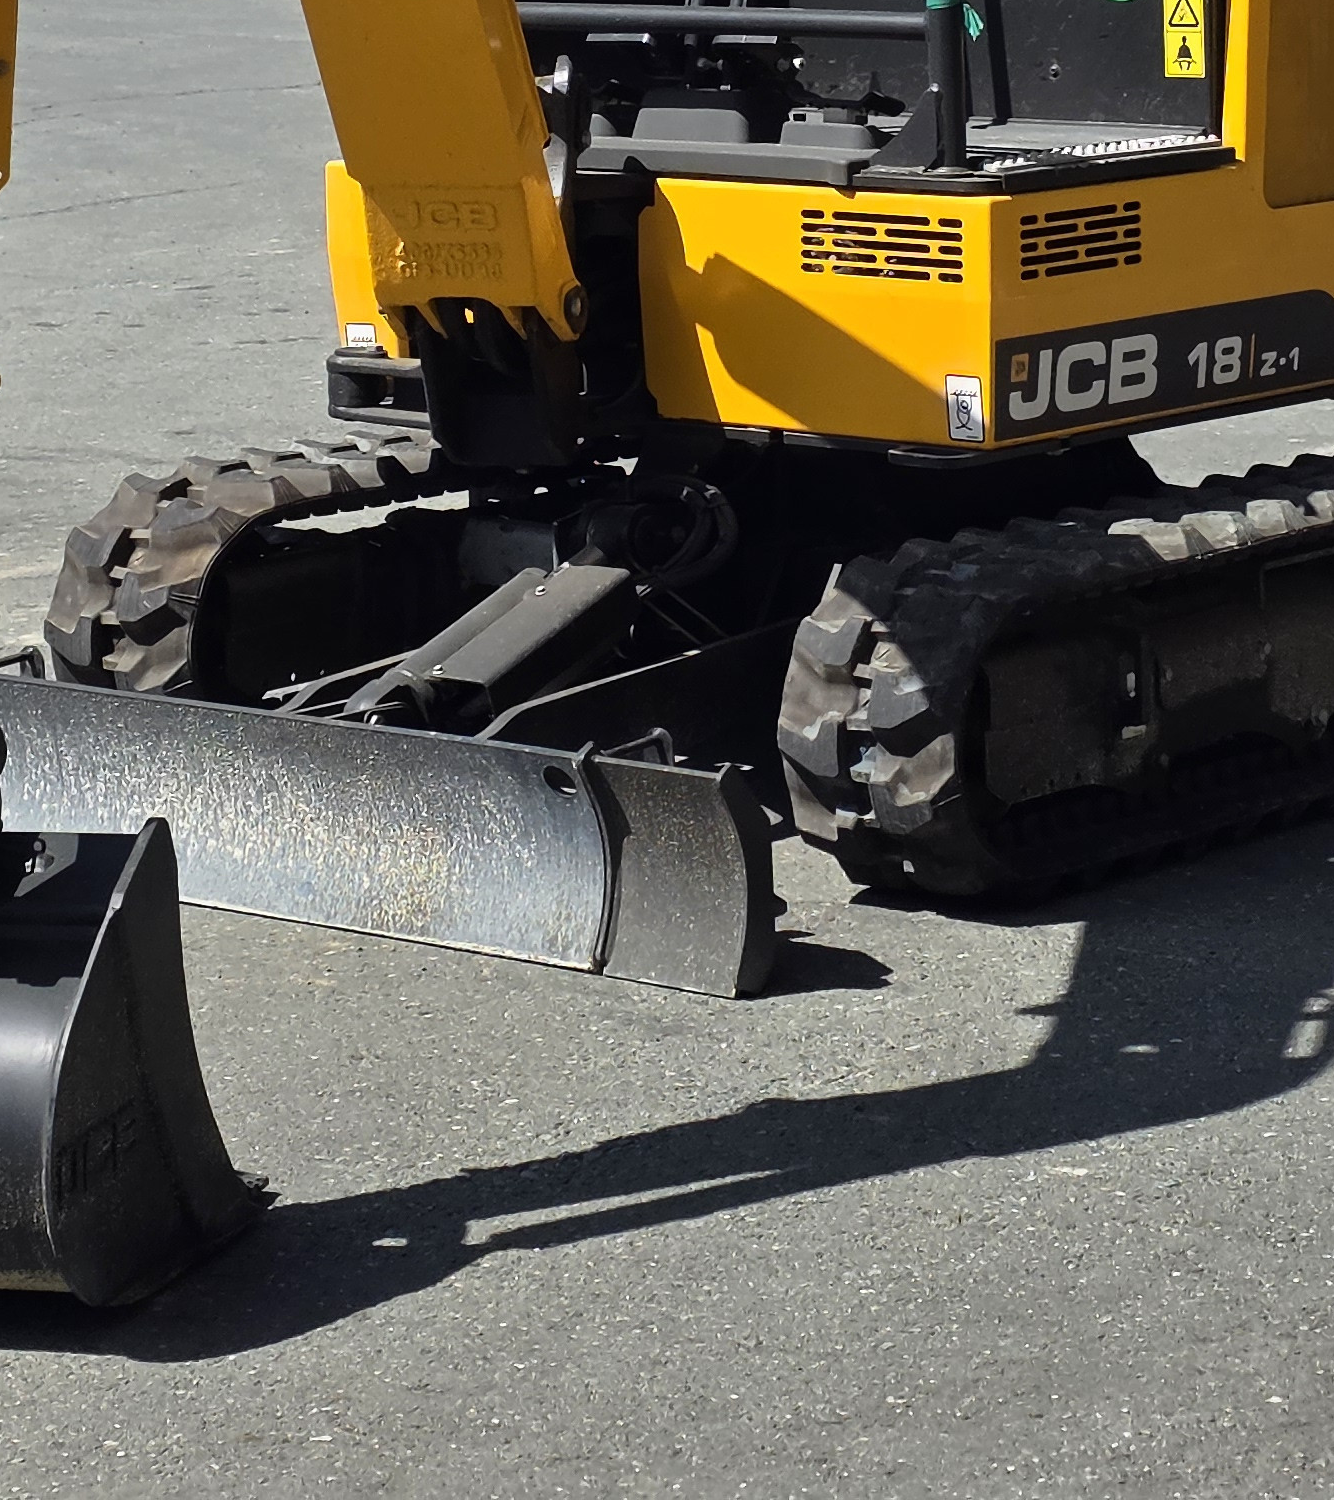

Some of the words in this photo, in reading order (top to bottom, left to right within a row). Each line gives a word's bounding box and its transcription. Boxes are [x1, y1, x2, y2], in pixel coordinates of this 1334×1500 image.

[388, 200, 498, 232] JCB
[1009, 333, 1159, 421] JCB
[1187, 336, 1243, 389] 18
